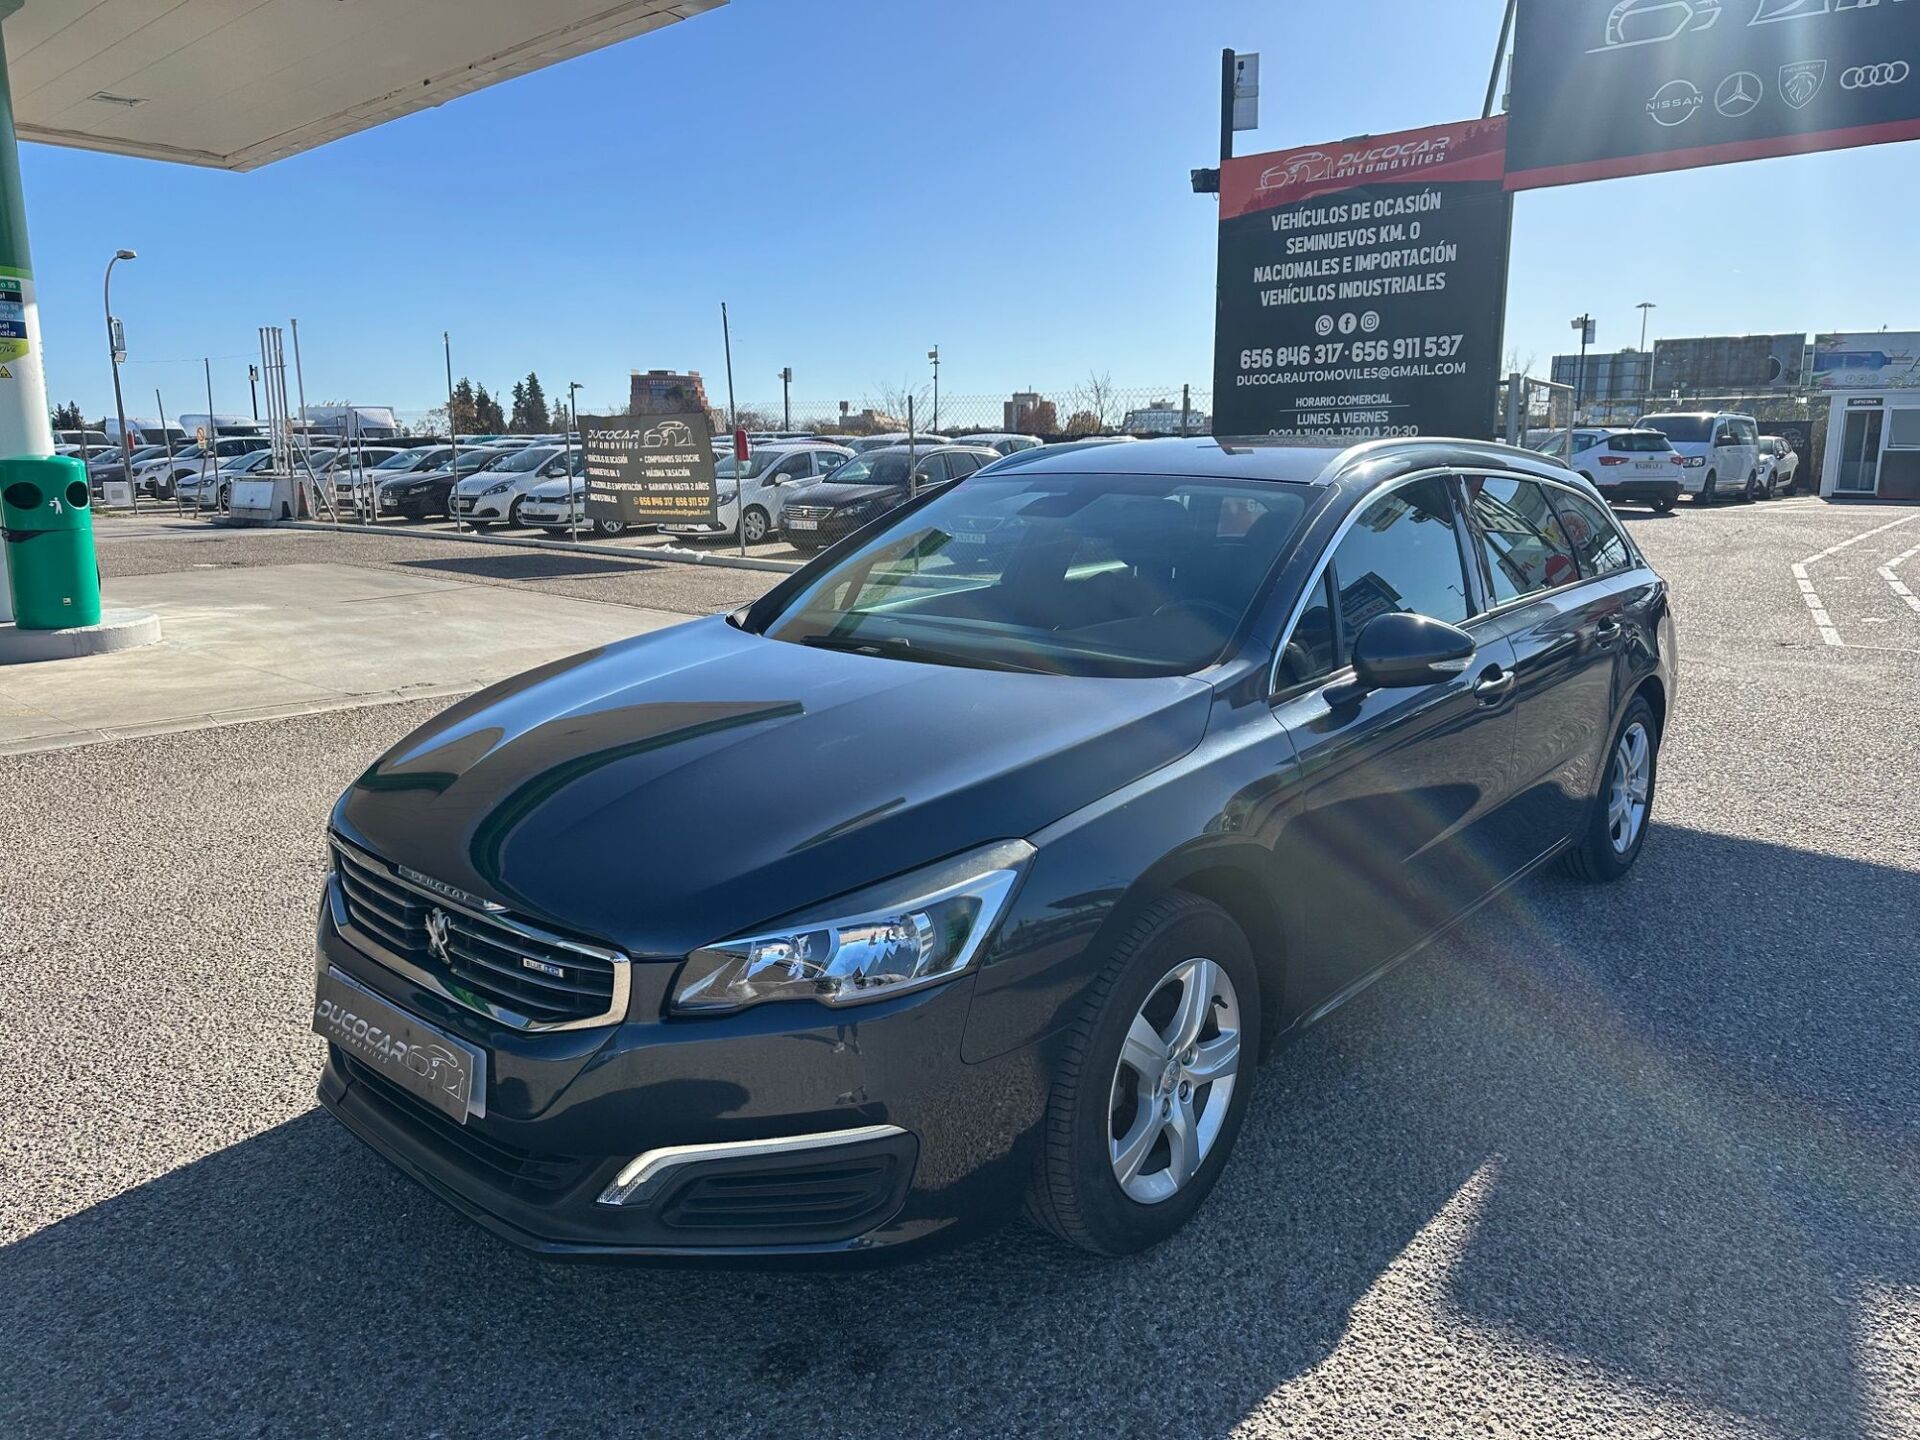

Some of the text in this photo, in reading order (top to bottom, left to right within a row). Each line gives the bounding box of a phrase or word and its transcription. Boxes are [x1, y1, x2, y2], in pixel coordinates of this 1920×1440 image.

[1645, 95, 1704, 111] NISSAN
[1336, 151, 1445, 178] automoviles
[1337, 136, 1450, 166] DUCOCAR
[1271, 188, 1442, 231] VEHÍCULOS DE OCASIÓN
[1286, 227, 1376, 255] SEMINUEVOS
[1379, 223, 1406, 244] KM.
[1253, 240, 1457, 283] NACIONALES E IMPORTACIÓN
[1260, 272, 1446, 307] VEHÍCULOS INDUSTRIALES
[1240, 348, 1273, 370] 656
[1276, 345, 1311, 367] 846
[1393, 337, 1419, 360] 911
[1424, 334, 1464, 358] 537
[1236, 362, 1466, 386] DUCOCARAUTOMOVILES@GMAIL.COM
[1296, 393, 1392, 408] HORARIO COMERCIAL
[1297, 410, 1389, 425] LUNES A VIERNES
[1383, 425, 1419, 437] 20:30
[587, 429, 640, 440] DUCOCAR
[698, 497, 710, 506] 537
[316, 999, 408, 1062] DUCOCAR
